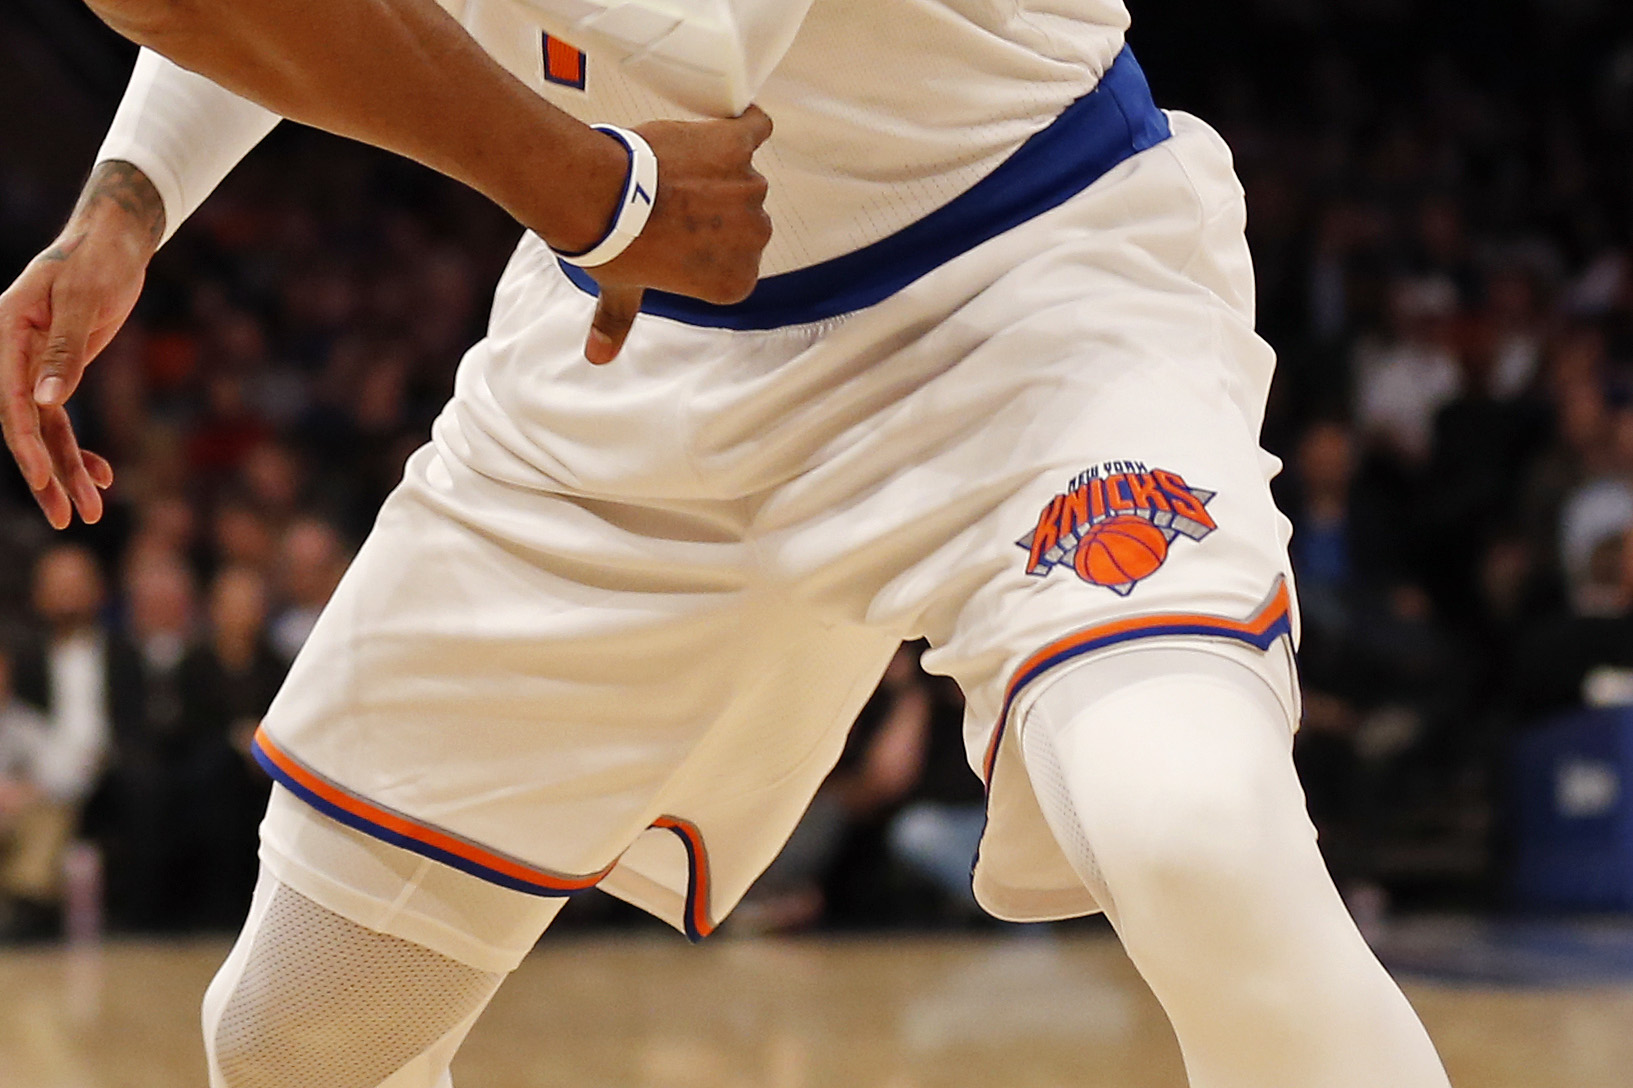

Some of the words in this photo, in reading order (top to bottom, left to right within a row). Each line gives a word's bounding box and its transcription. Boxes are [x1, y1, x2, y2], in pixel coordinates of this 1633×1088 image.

[1068, 464, 1099, 492] NEW
[1104, 460, 1149, 475] YORK
[1025, 468, 1218, 576] KNICKS
